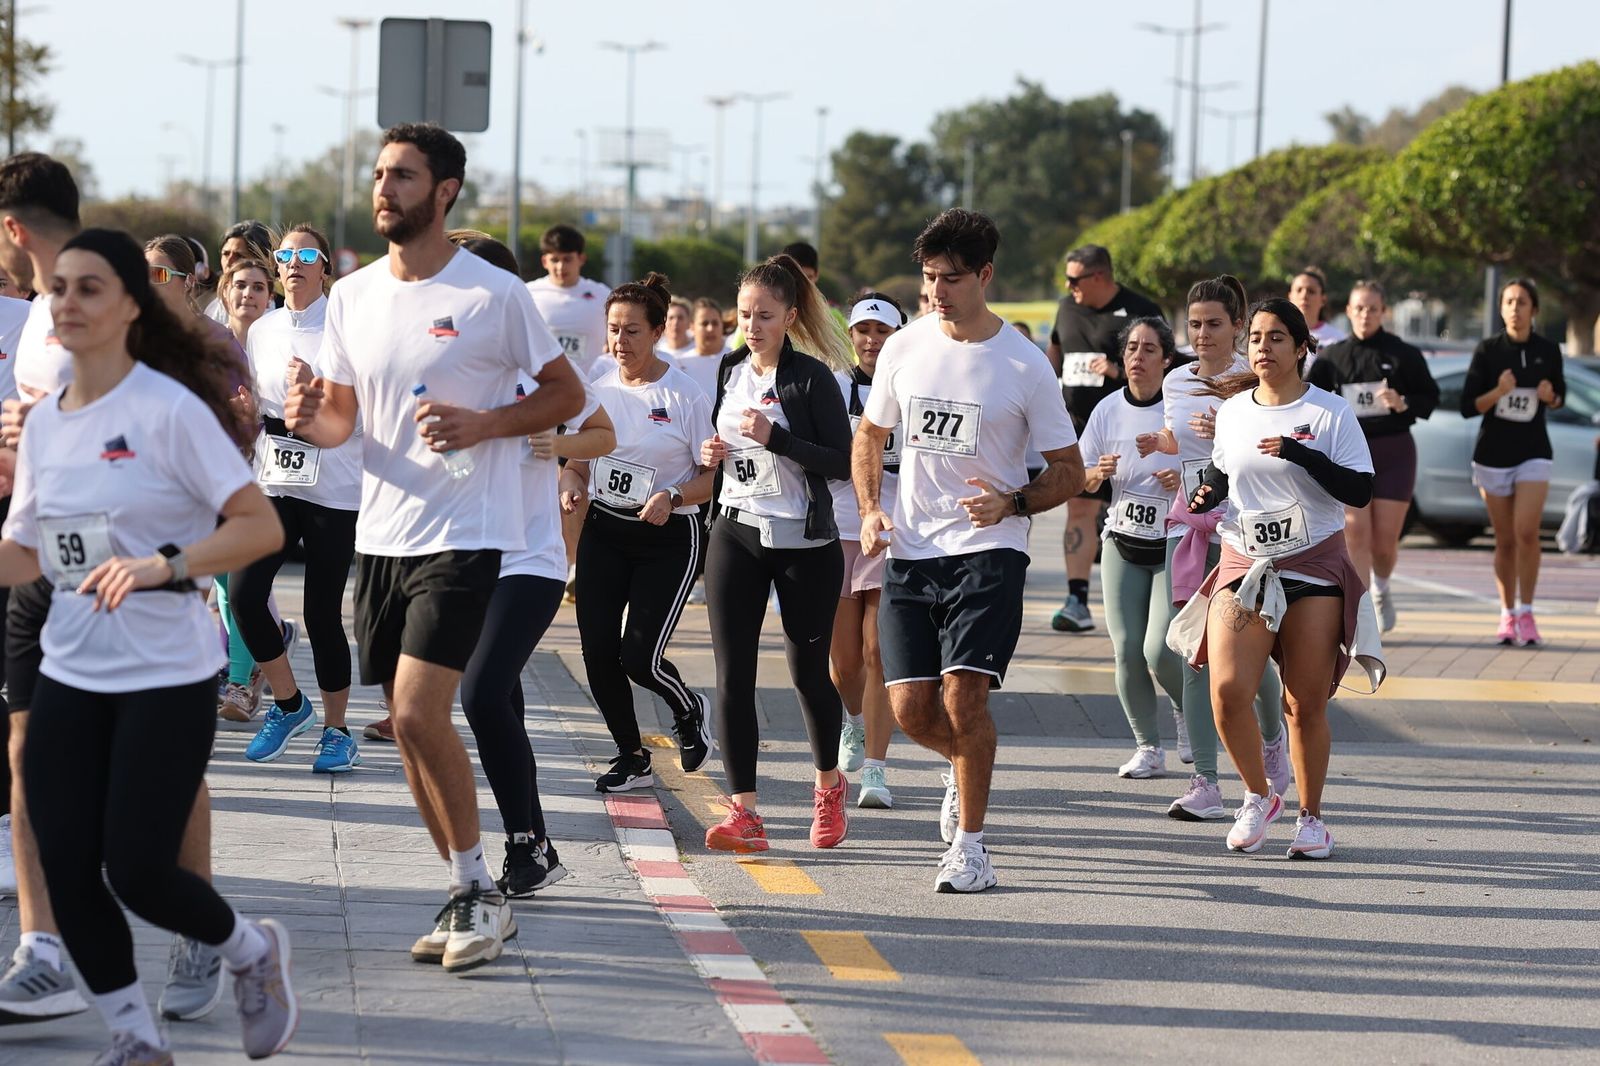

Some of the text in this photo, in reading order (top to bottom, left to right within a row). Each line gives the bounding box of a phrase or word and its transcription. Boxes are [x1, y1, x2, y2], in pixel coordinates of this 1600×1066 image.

[1357, 391, 1374, 406] 49
[1509, 395, 1529, 410] 142
[921, 410, 964, 437] 277
[274, 448, 305, 470] 183
[734, 458, 757, 483] 54
[608, 468, 633, 494] 58
[1125, 502, 1157, 525] 438
[1254, 517, 1292, 544] 397
[57, 532, 86, 566] 59
